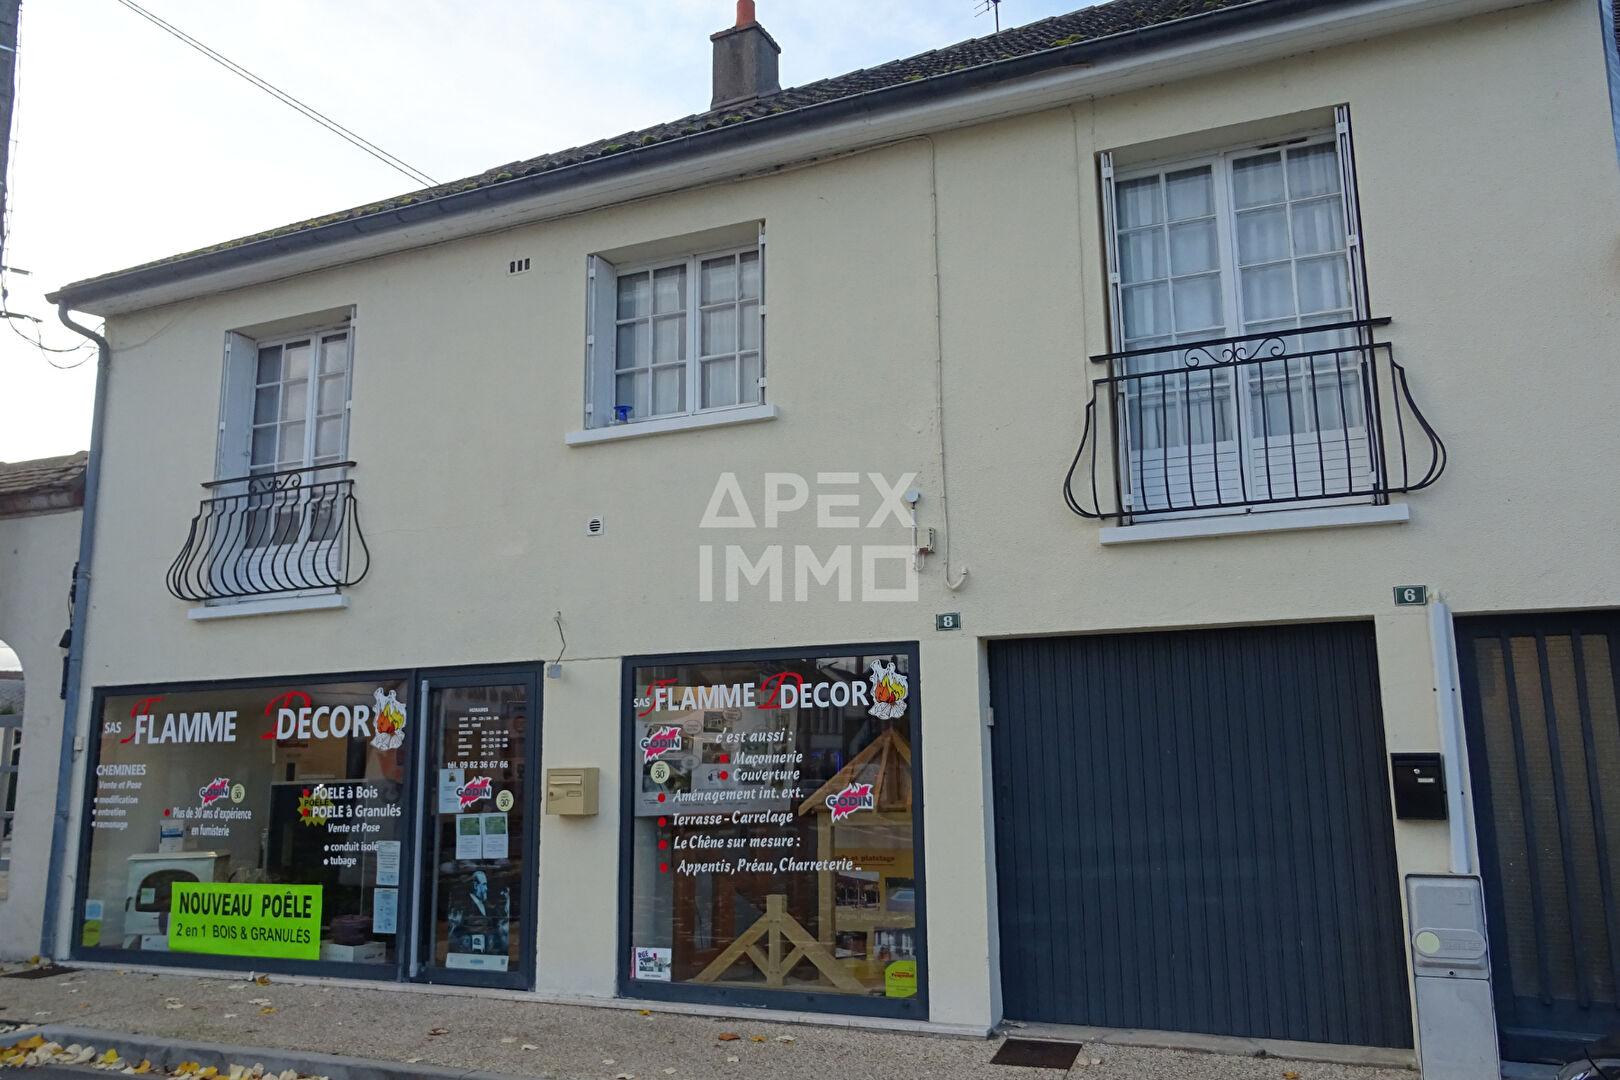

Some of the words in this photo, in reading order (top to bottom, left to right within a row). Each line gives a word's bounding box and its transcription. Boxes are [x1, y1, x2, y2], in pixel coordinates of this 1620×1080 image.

[1404, 589, 1415, 602] 6
[943, 615, 953, 627] 8
[633, 698, 650, 708] SAS
[655, 682, 756, 712] FLAMME
[780, 681, 869, 709] DECOR
[104, 721, 122, 734] SAS
[134, 711, 237, 744] FLAMME
[276, 705, 371, 740] DECOR
[715, 728, 746, 743] c'est
[640, 739, 680, 749] GODIN
[460, 761, 469, 769] 09
[470, 761, 479, 769] 82
[480, 761, 489, 769] 36
[490, 761, 499, 769] 67
[500, 760, 509, 769] 66
[733, 750, 803, 767] Maçonnerie
[96, 764, 147, 776] CHEMINEES
[655, 769, 665, 779] 30
[733, 768, 800, 781] Couverture
[200, 788, 229, 797] GODIN
[313, 787, 345, 800] POELE
[347, 786, 353, 798] à
[356, 785, 378, 799] Bois
[456, 788, 490, 797] GODIN
[673, 789, 757, 804] Aménagement
[827, 795, 872, 807] GODIN
[173, 807, 185, 819] Plus
[186, 807, 194, 818] de
[194, 807, 202, 819] 30
[202, 810, 213, 819] ans
[213, 807, 252, 822] d'expérience
[312, 805, 344, 818] POELE
[355, 803, 401, 817] Granulés
[191, 827, 199, 836] en
[200, 824, 230, 836] fumisterie
[328, 823, 350, 833] Vente
[351, 824, 360, 832] et
[361, 823, 380, 832] Pose
[330, 842, 359, 851] conduit
[674, 836, 687, 849] Le
[689, 835, 724, 849] Chêne
[727, 838, 746, 848] sur
[330, 855, 357, 868] tubage
[179, 892, 253, 917] NOUVEAU
[261, 890, 312, 919] POÊLE
[176, 923, 183, 937] 2
[185, 926, 198, 937] en
[201, 924, 206, 937] 1
[212, 924, 238, 940] BOIS
[240, 926, 248, 940] &
